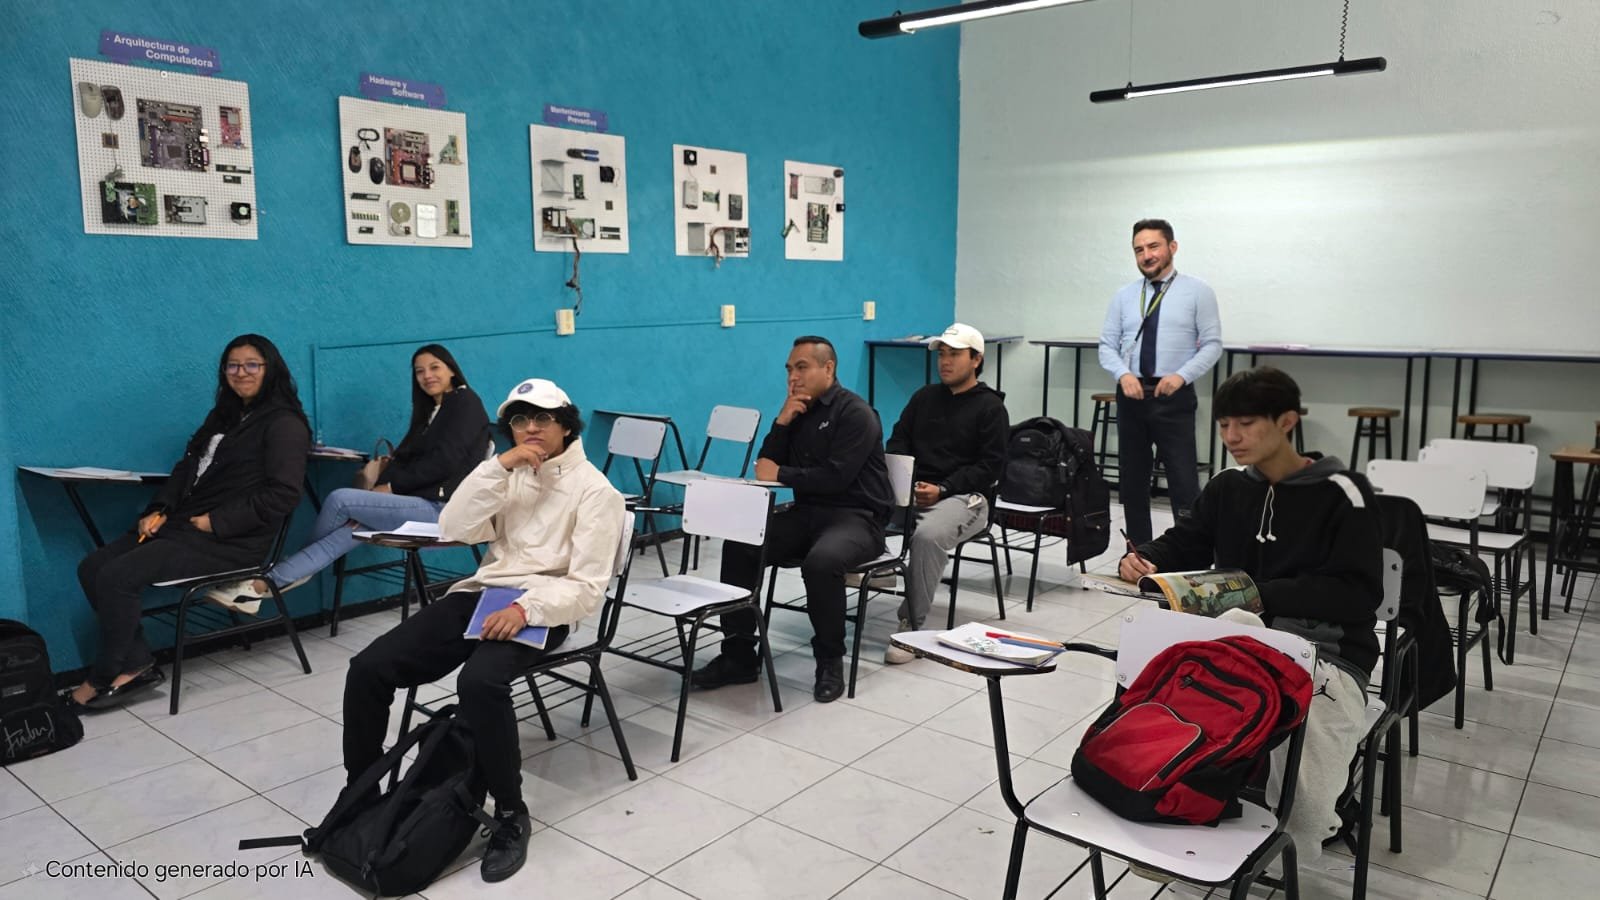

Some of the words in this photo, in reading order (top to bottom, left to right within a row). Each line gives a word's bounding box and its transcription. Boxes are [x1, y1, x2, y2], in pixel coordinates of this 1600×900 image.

[114, 34, 175, 51] Arquitectura
[177, 45, 190, 54] de
[145, 49, 213, 68] Computadora
[392, 87, 424, 100] Software
